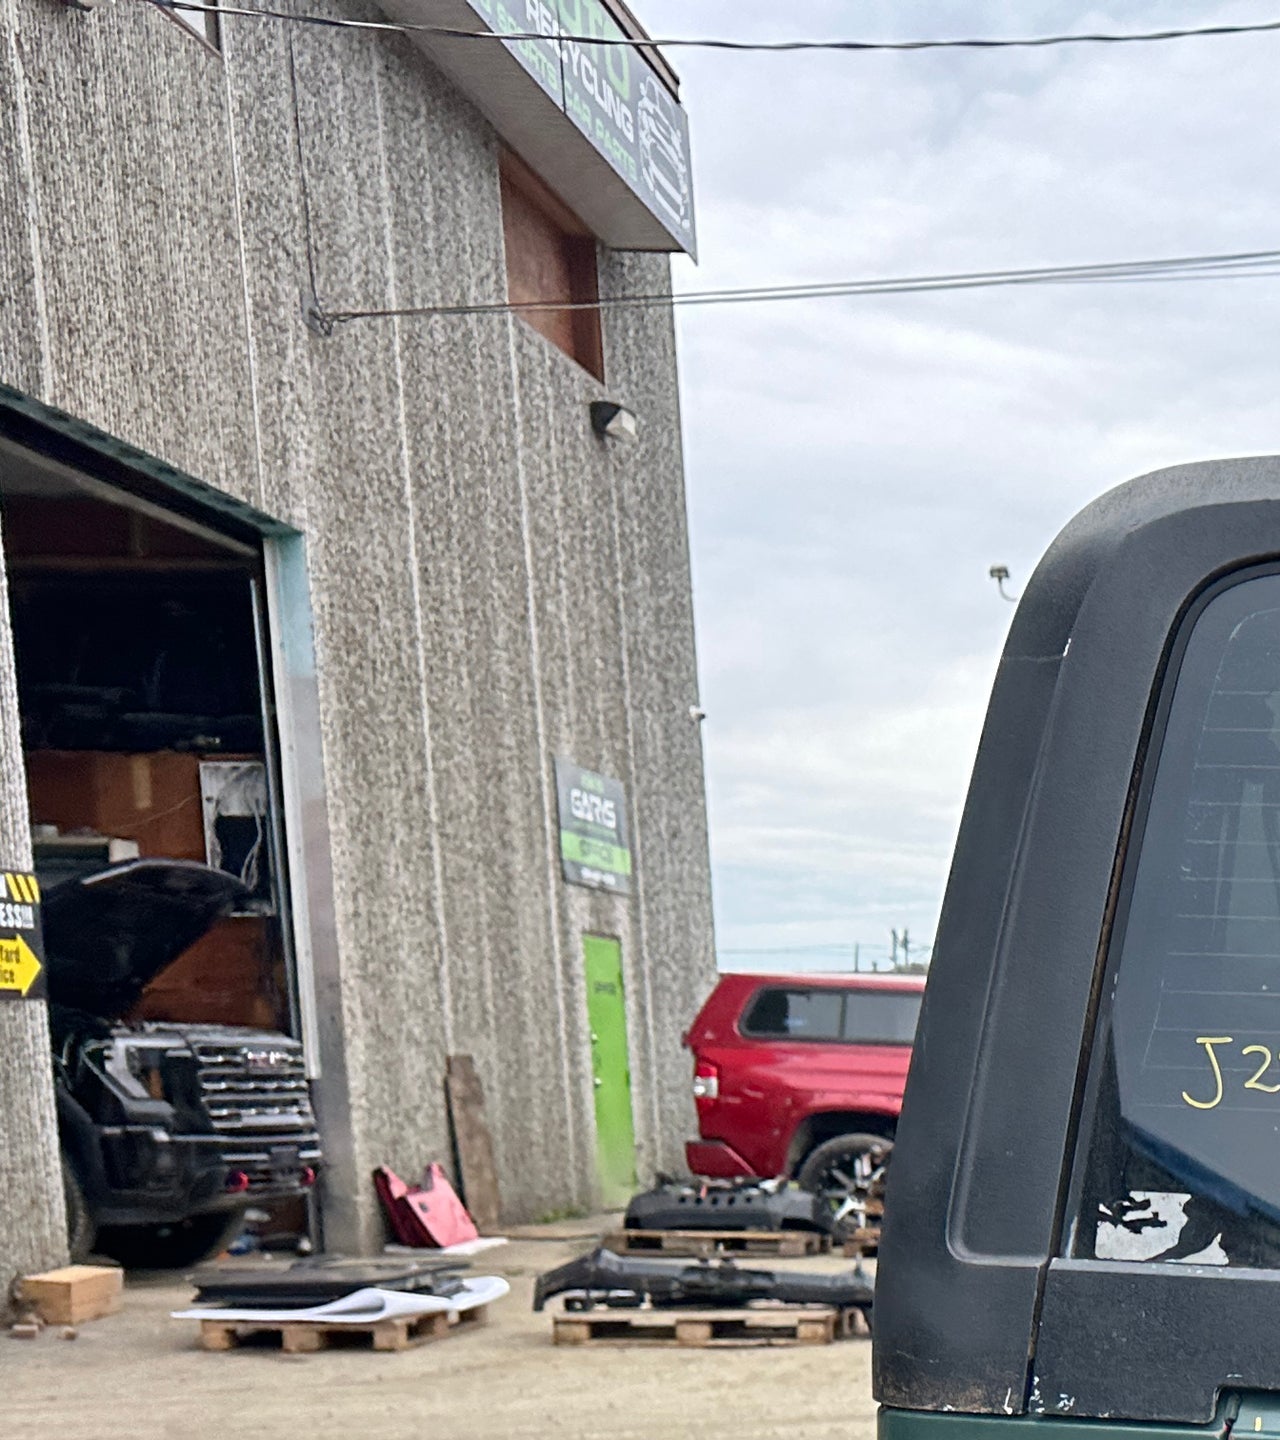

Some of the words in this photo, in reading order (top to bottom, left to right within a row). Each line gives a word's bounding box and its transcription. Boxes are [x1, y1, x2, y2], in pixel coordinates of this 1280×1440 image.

[526, 0, 635, 143] RECYCLING
[563, 79, 592, 129] CAR
[595, 119, 638, 182] PARTS
